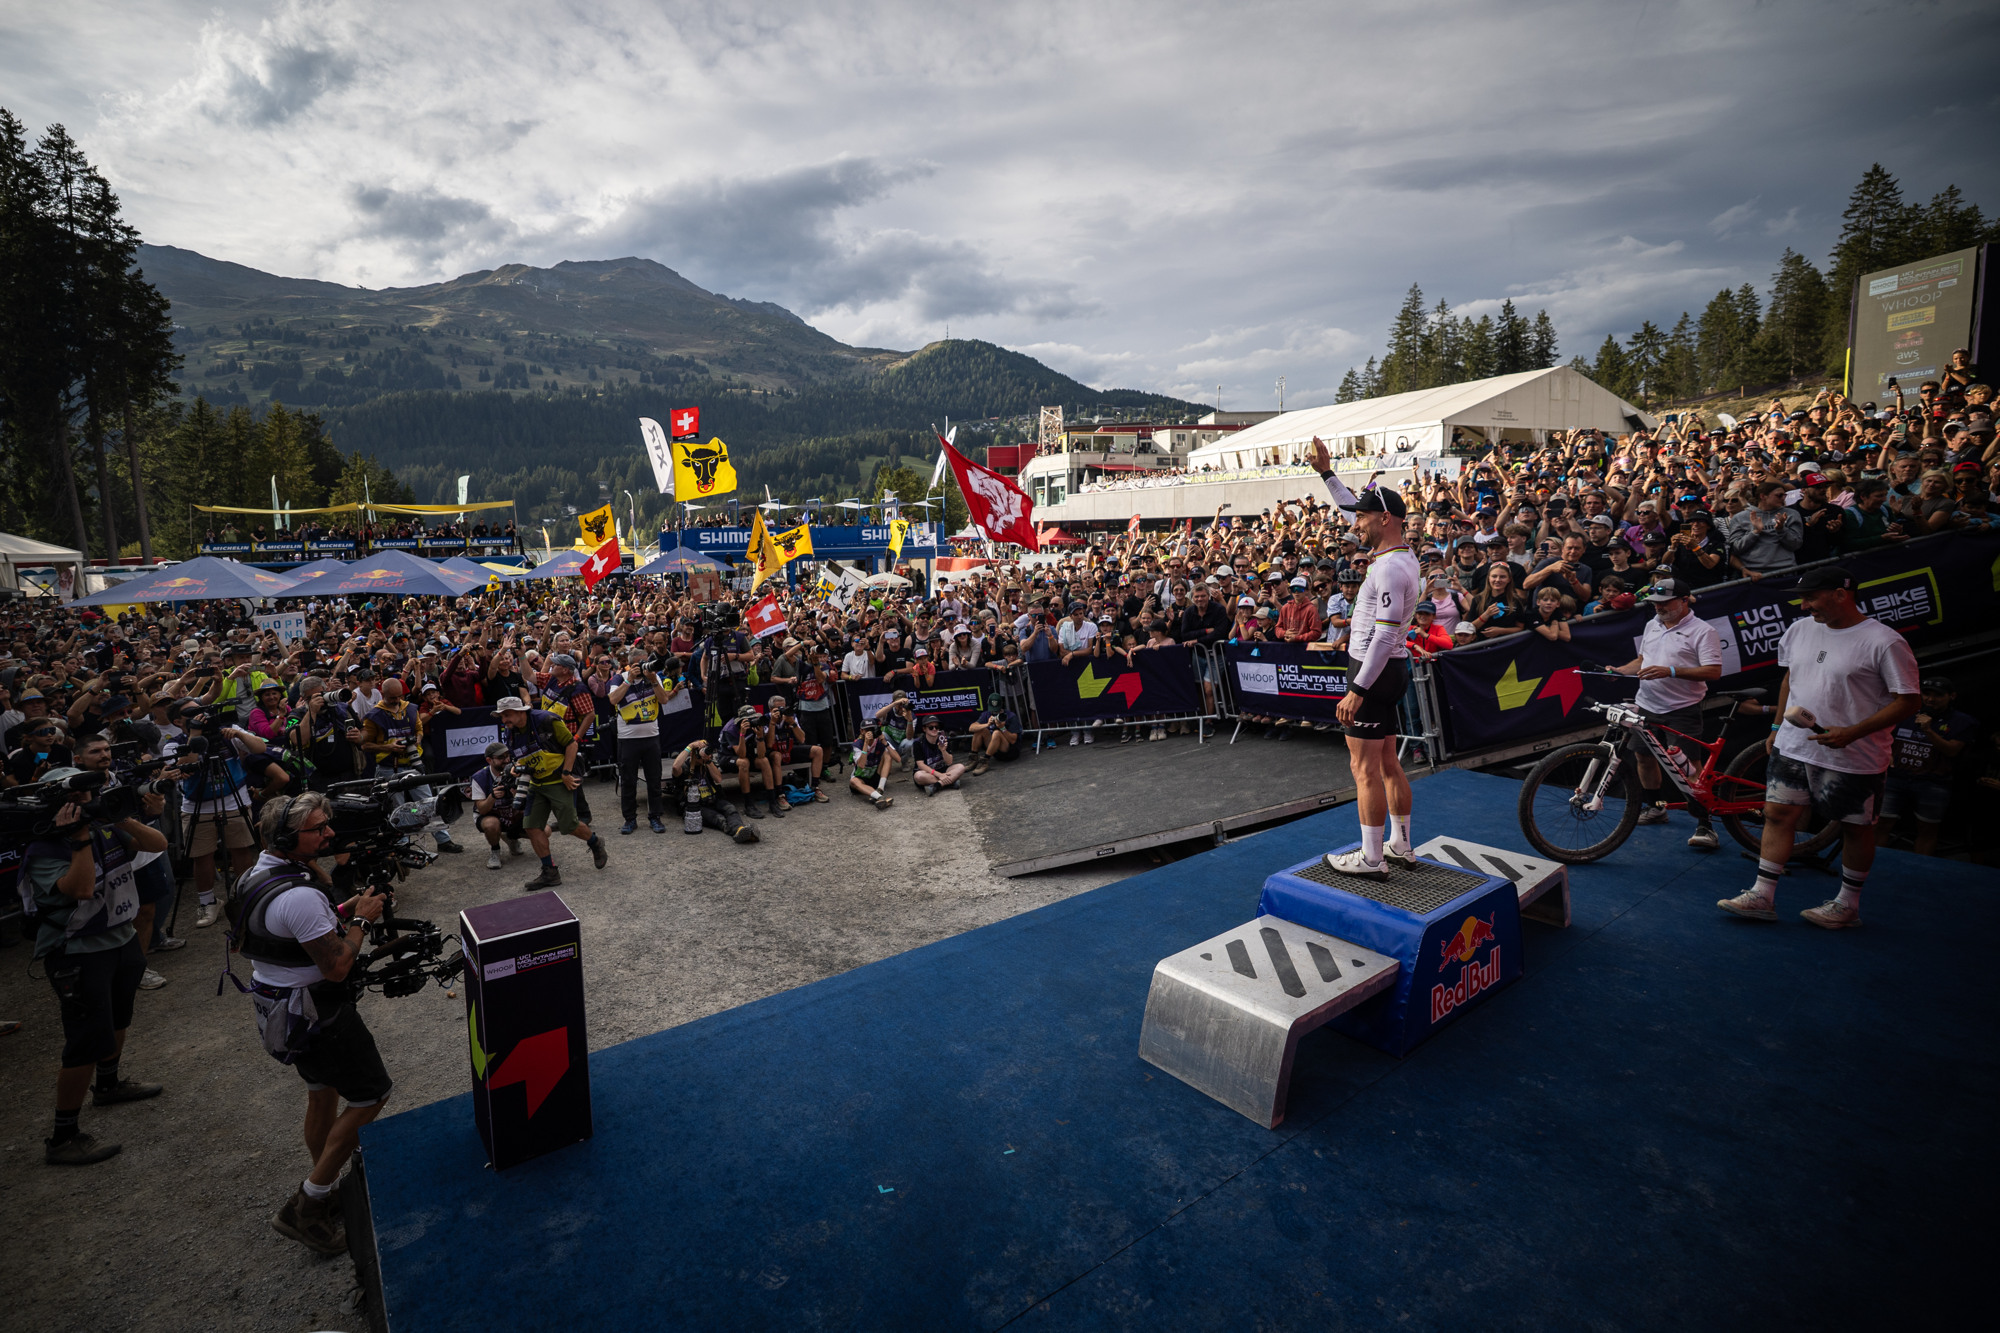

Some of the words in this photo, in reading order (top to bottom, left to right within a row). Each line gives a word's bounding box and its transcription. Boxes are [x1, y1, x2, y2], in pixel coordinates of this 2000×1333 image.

[1882, 291, 1942, 312] WHOOP
[1896, 350, 1919, 360] aws
[1895, 369, 1935, 379] MICHELIN
[338, 581, 371, 590] Red
[372, 578, 405, 588] Bull
[134, 587, 170, 598] Red
[170, 586, 208, 596] Bull
[1872, 586, 1928, 610] BIKE
[1743, 603, 1783, 625] UCI
[262, 618, 303, 630] HOPP
[1281, 665, 1299, 674] UCI
[1241, 673, 1275, 683] WHOOP
[1278, 673, 1339, 684] MOUNTAIN
[1280, 681, 1323, 691] WORLD
[952, 693, 977, 701] BIKE
[940, 700, 978, 709] SERIES
[1609, 712, 1618, 721] 10
[450, 735, 495, 747] WHOOP
[1901, 748, 1930, 759] RADIO
[1903, 743, 1931, 753] VIDEO
[1900, 757, 1923, 767] 013
[517, 951, 556, 965] MOUNTAIN
[557, 947, 575, 955] BIKE
[517, 957, 547, 969] WORLD
[547, 952, 575, 962] SERIES
[519, 953, 532, 961] UCI
[486, 964, 514, 975] WHOOP
[1431, 964, 1468, 1025] Red
[1468, 944, 1501, 1000] Bull
